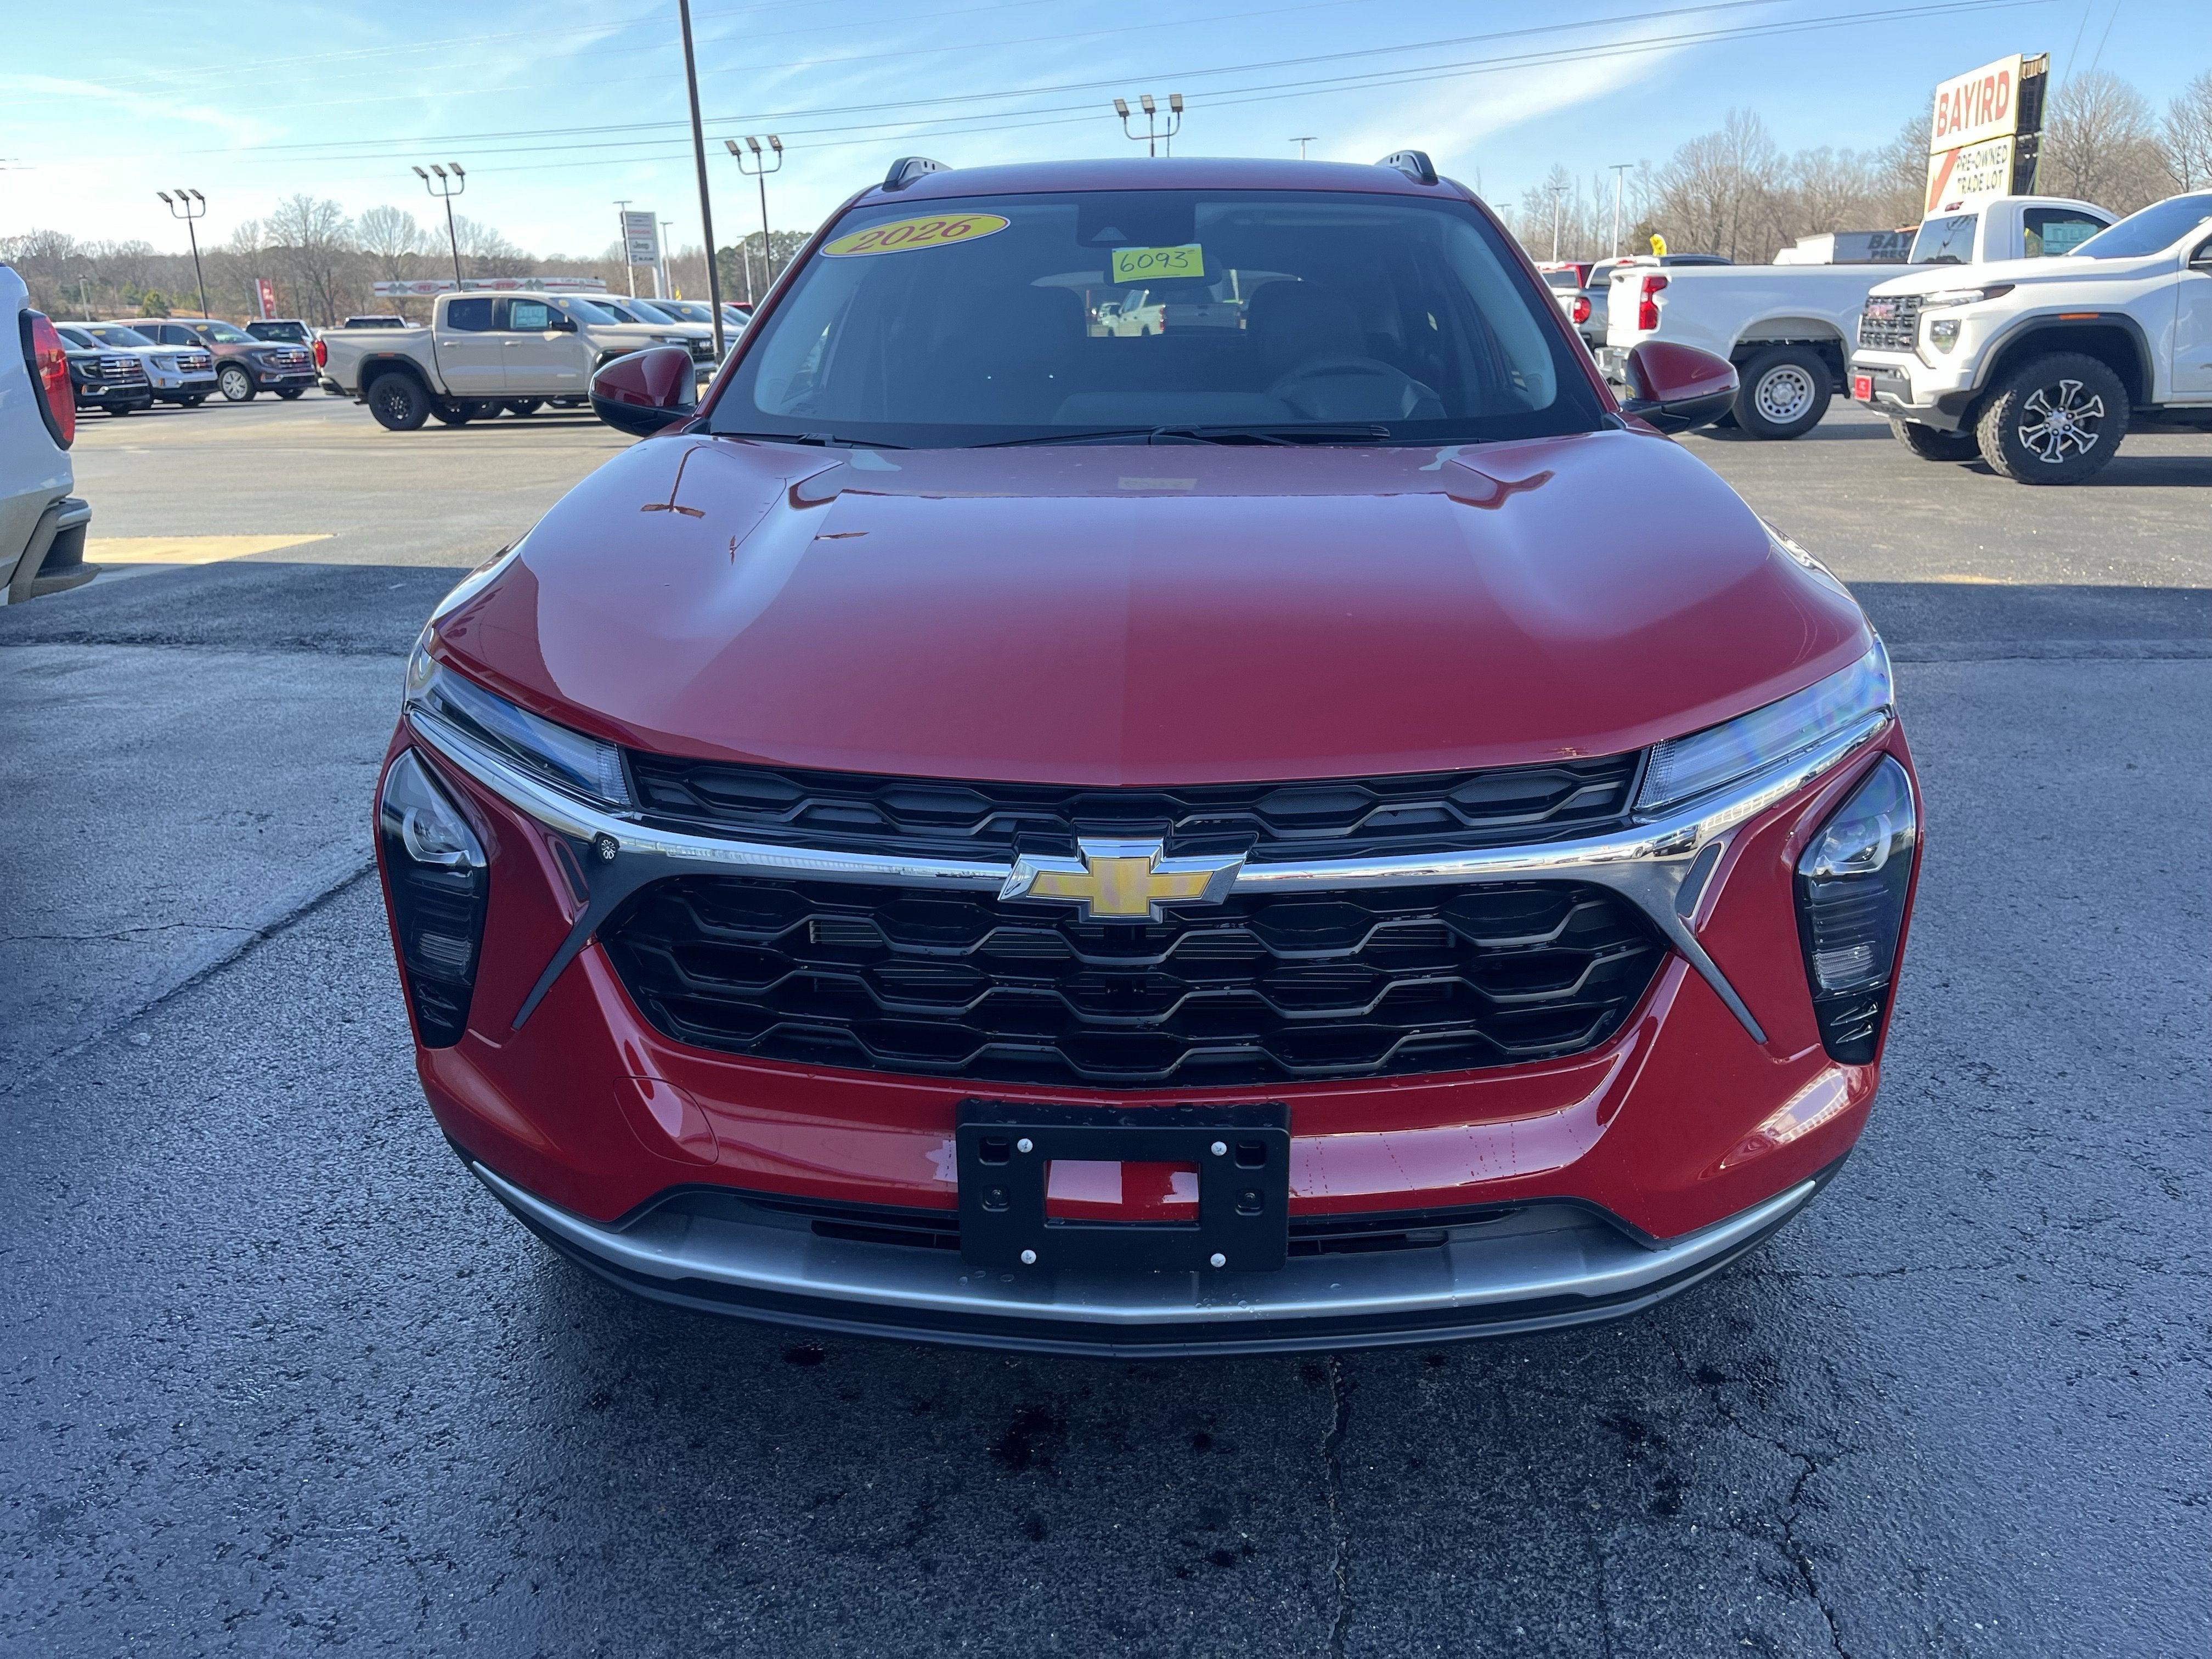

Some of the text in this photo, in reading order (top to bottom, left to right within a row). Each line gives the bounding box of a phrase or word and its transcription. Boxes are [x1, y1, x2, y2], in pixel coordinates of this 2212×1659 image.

[1937, 70, 2010, 137] BAYIRD
[1957, 145, 2008, 171] PRE-OWNED
[1957, 170, 2004, 194] TRADE LOT
[846, 217, 982, 253] 2026
[1120, 251, 1189, 272] 6093
